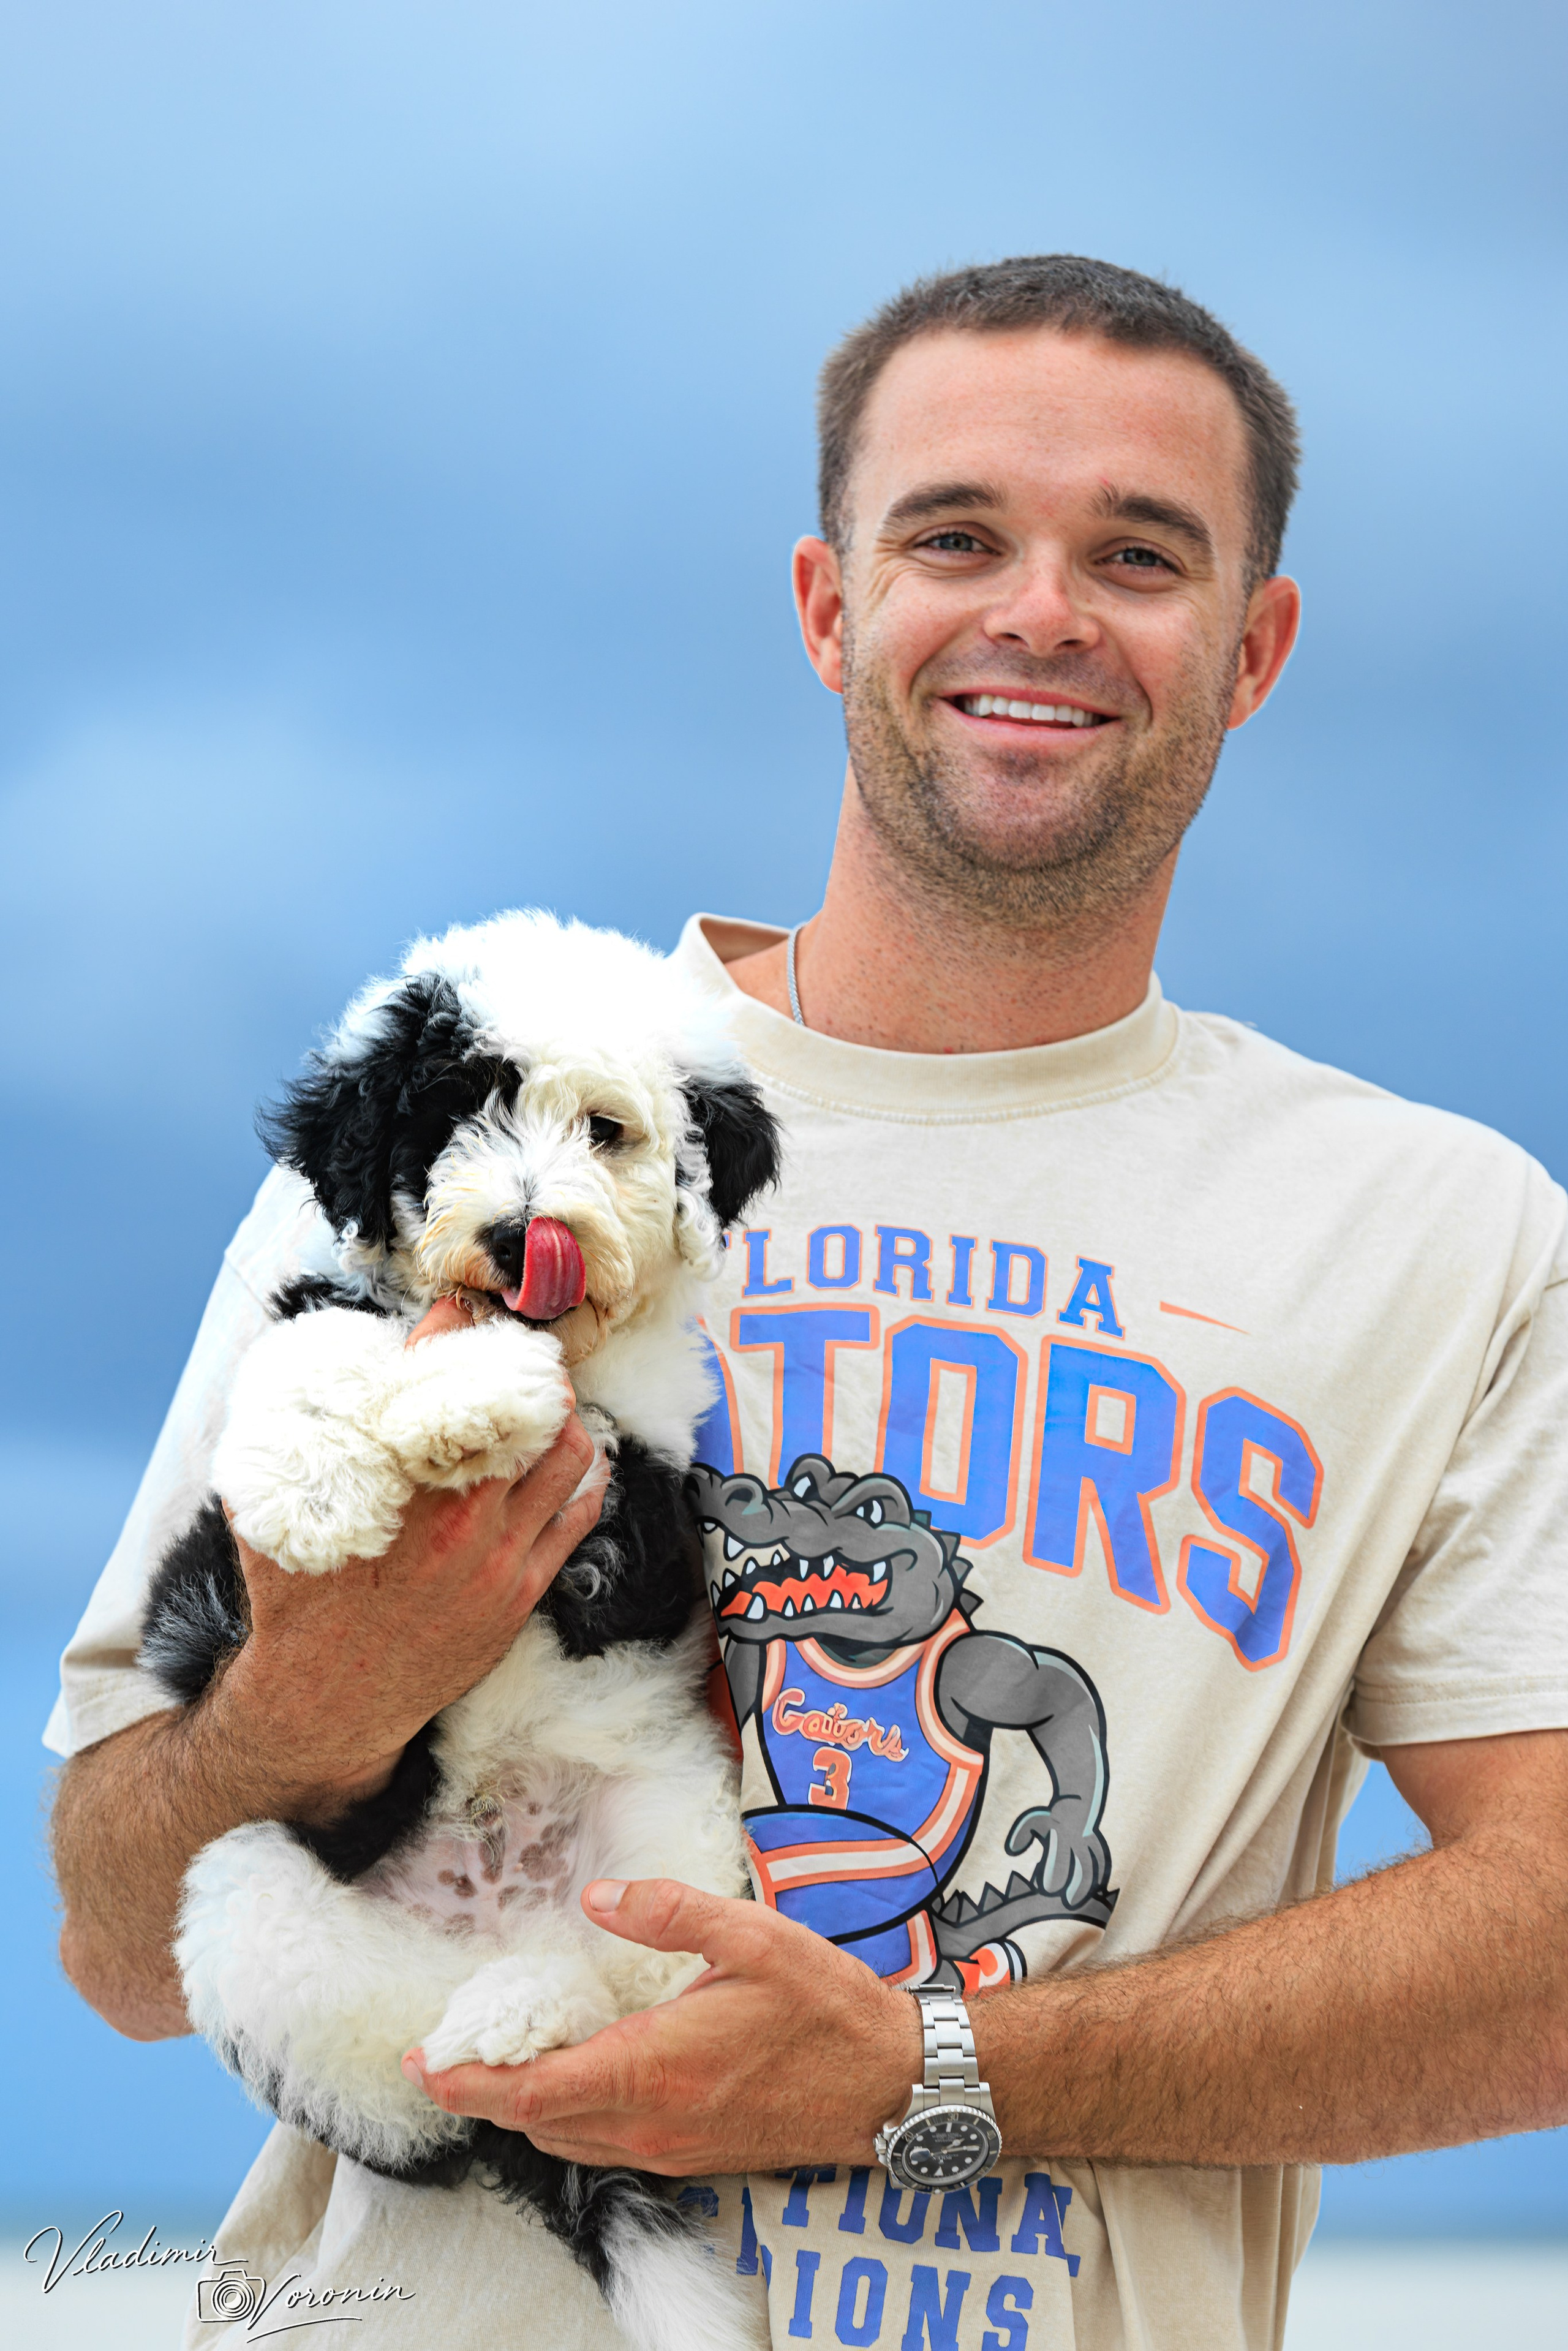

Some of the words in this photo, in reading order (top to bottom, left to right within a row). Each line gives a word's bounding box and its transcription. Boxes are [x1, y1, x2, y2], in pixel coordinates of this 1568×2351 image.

[723, 1223, 1125, 1340] LORIDA
[772, 1688, 909, 1762] Gators
[808, 1746, 852, 1810] 3
[775, 2165, 1080, 2277] TIONA
